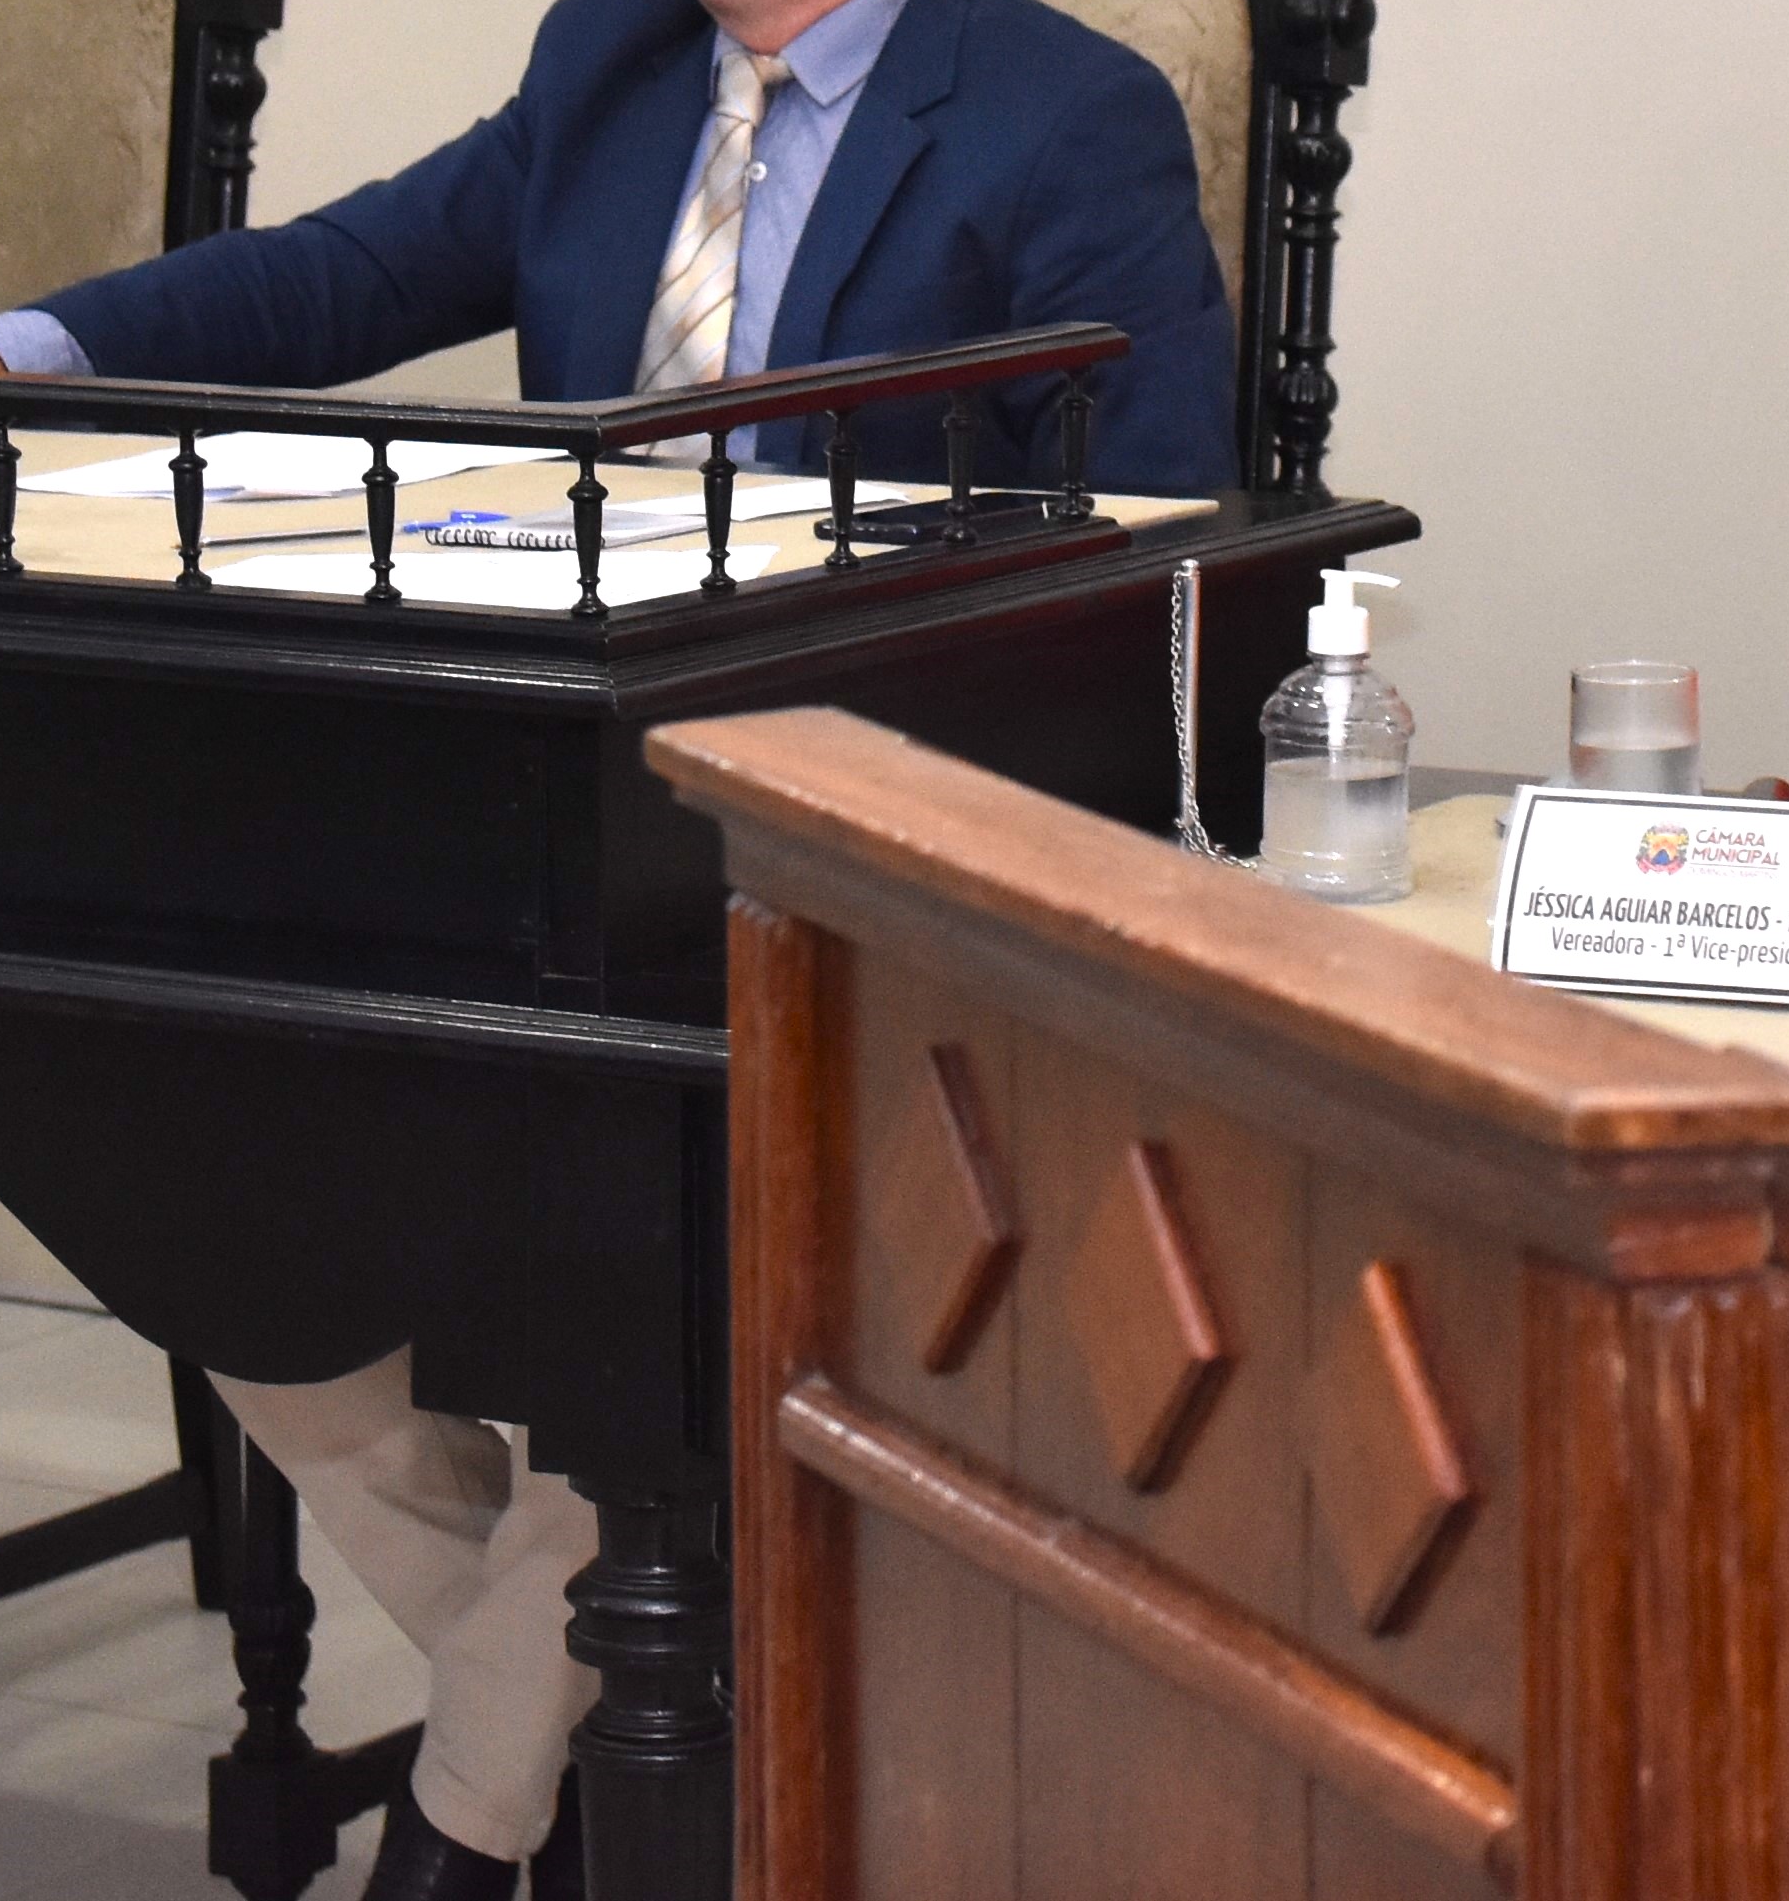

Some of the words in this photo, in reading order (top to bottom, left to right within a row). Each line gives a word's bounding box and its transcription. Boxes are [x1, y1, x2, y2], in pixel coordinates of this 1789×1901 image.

[1695, 826, 1766, 847] CÂMARA
[1691, 846, 1781, 866] MUNICIPAL
[1523, 886, 1594, 920] JÉSSICA
[1600, 897, 1671, 925] AGUIAR
[1676, 901, 1771, 931] BARCELOS
[1552, 926, 1644, 955] Vereadora
[1663, 933, 1686, 957] 1ª
